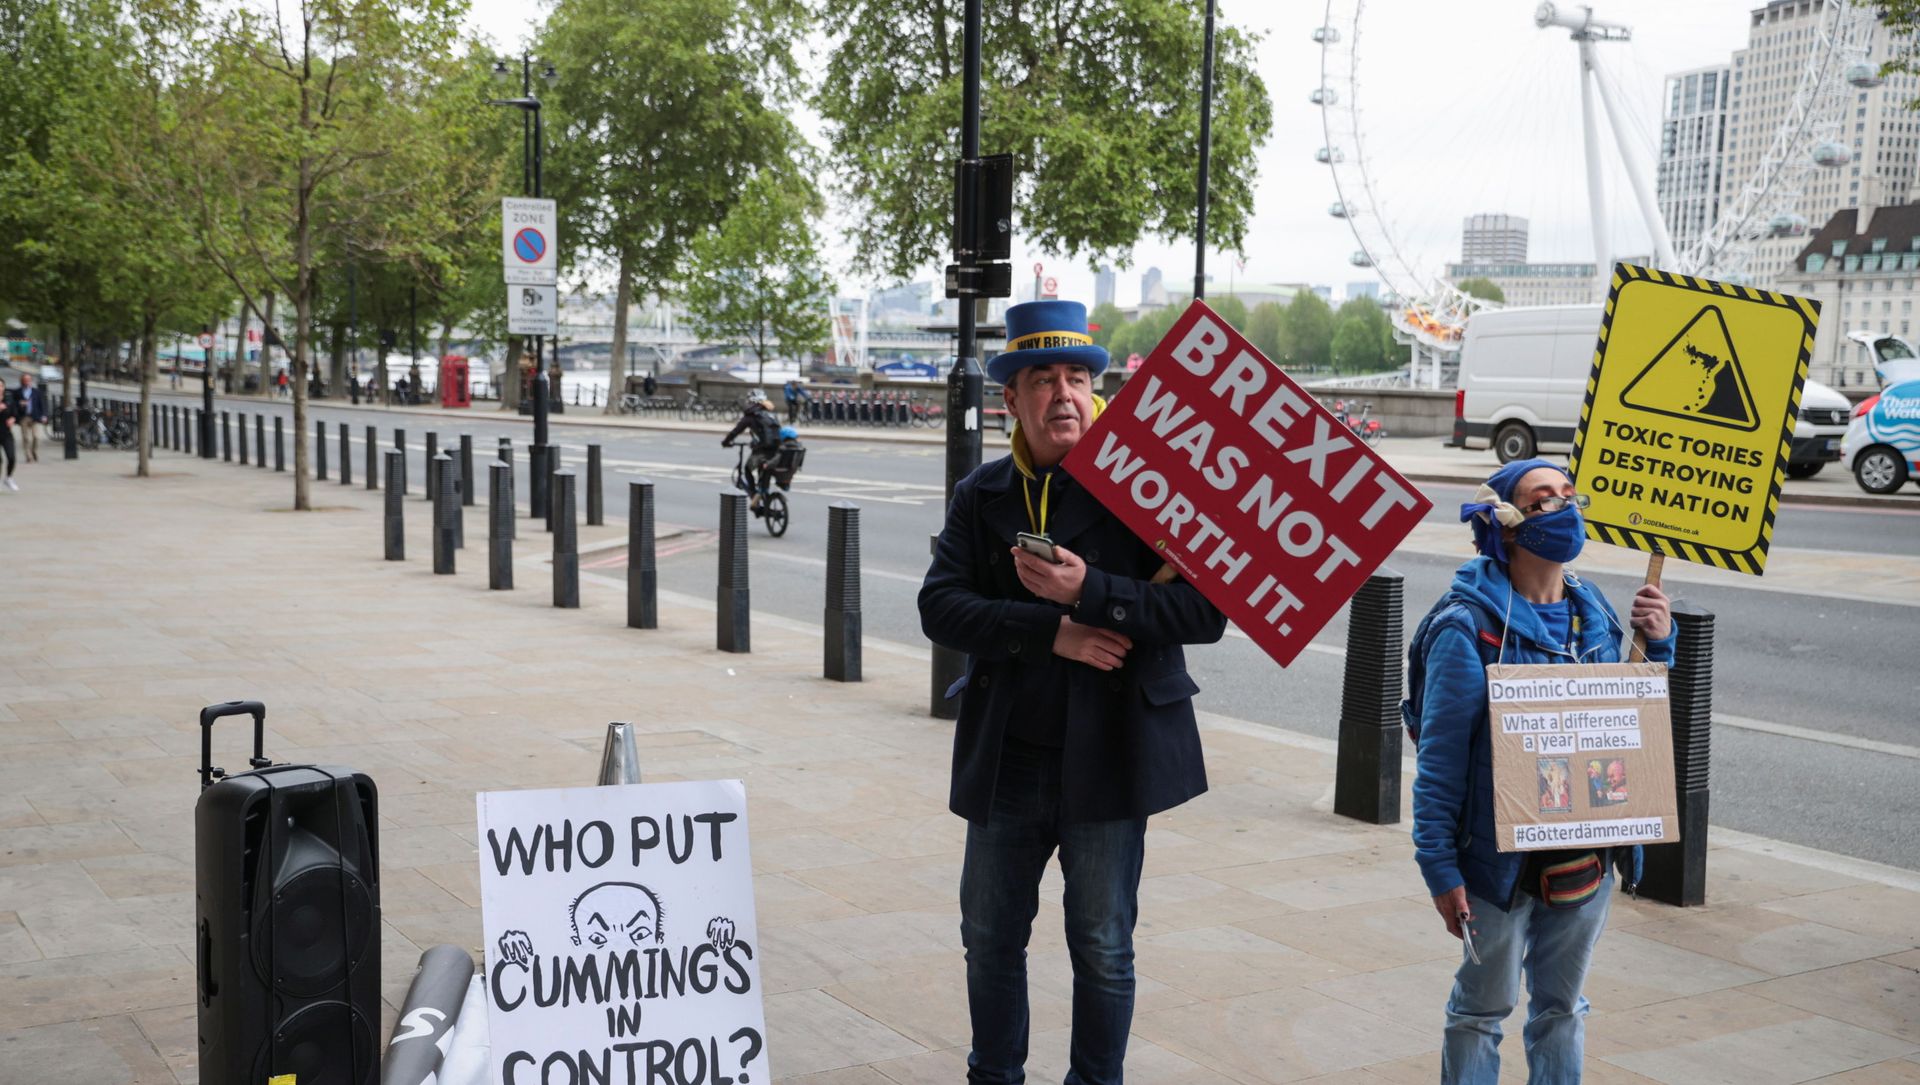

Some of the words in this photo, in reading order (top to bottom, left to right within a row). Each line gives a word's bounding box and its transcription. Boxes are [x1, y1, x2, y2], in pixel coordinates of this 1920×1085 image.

[512, 213, 546, 225] ZONE
[1017, 337, 1041, 351] WHY
[1170, 315, 1417, 530] BREXIT
[1603, 420, 1674, 449] TOXIC
[1678, 435, 1763, 467] TORIES
[1134, 376, 1249, 491] WAS
[1237, 474, 1361, 583] NOT
[1598, 448, 1753, 494] DESTROYING
[1591, 475, 1644, 501] OUR
[1650, 487, 1750, 523] NATION
[1093, 431, 1252, 585] WORTH
[1246, 574, 1304, 637] IT.
[1491, 680, 1563, 700] Dominic
[1566, 678, 1666, 698] Cummings...
[1503, 715, 1547, 731] What
[1550, 719, 1558, 730] a
[1564, 713, 1637, 729] difference
[1525, 737, 1533, 749] a
[1541, 735, 1573, 751] year
[1581, 733, 1639, 748] makes...
[487, 819, 614, 876] WHO
[631, 812, 737, 867] PUT
[1516, 821, 1662, 843] #Götterdämmerung
[491, 939, 753, 1011] CUMMINGS
[607, 1002, 641, 1037] IN
[503, 1026, 762, 1085] CONTROL?
